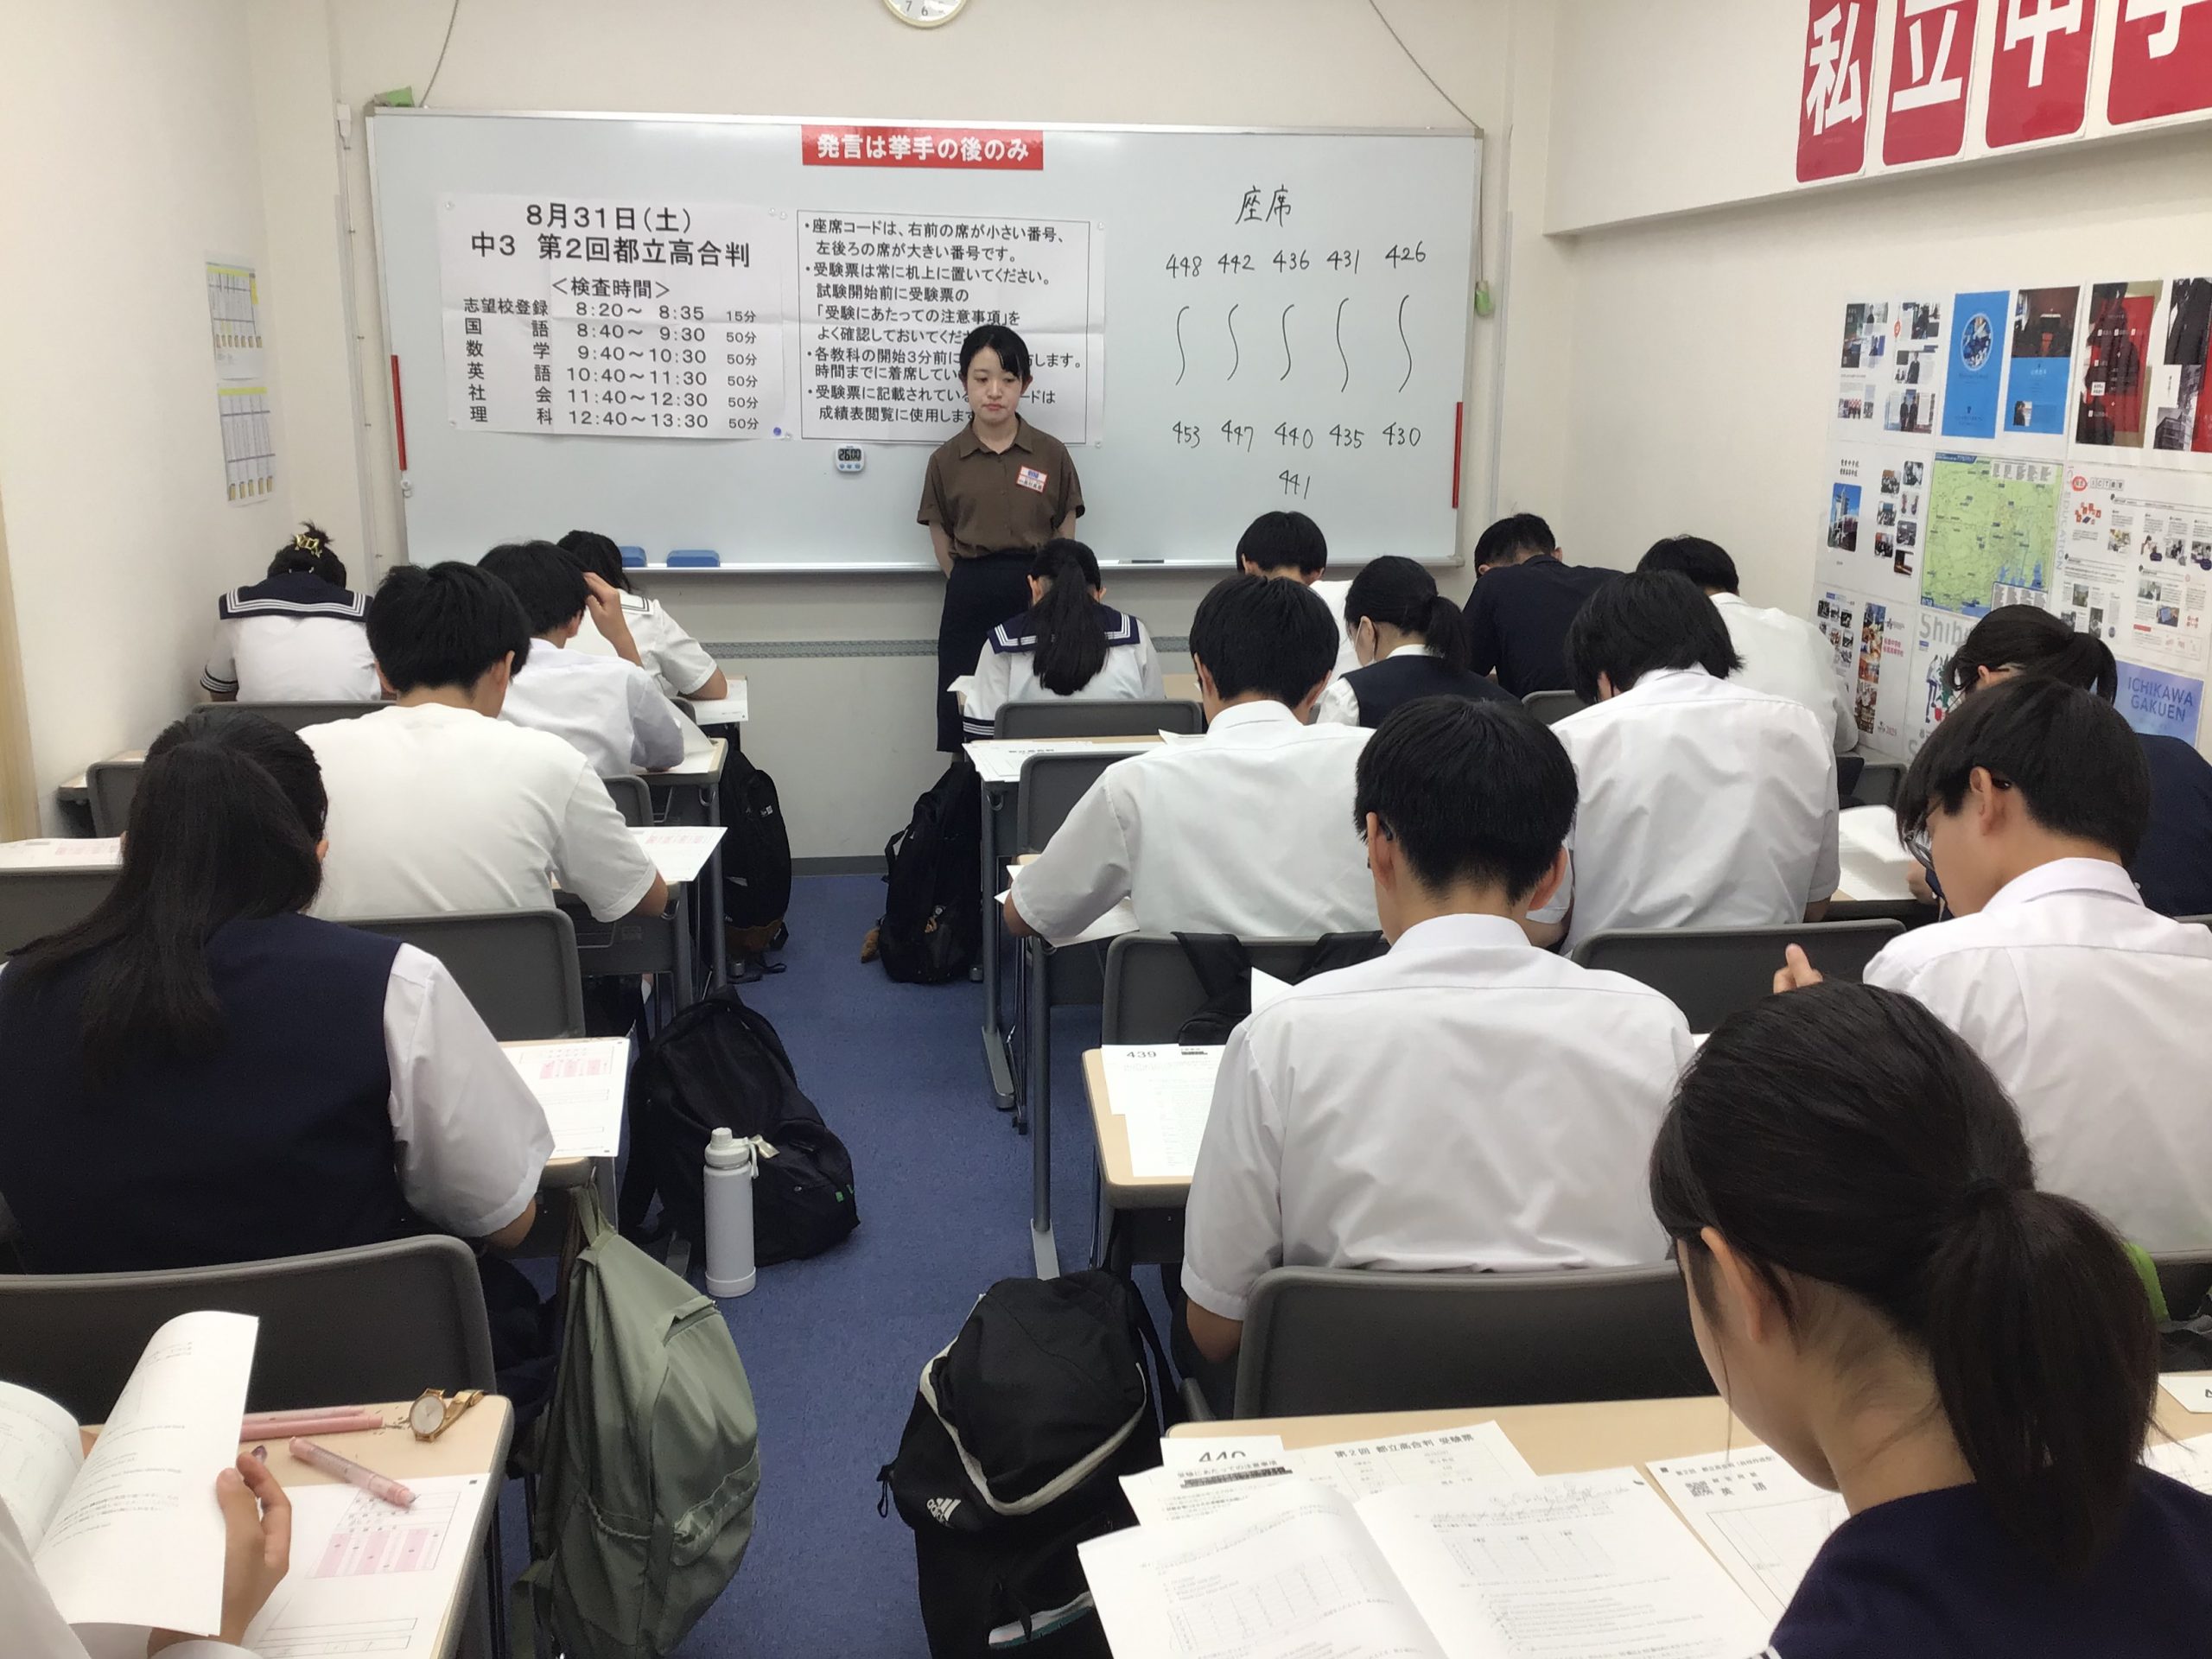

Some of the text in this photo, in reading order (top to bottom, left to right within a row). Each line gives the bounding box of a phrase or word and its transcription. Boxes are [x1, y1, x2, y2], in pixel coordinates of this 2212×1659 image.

[921, 6, 929, 16] 6
[817, 133, 1029, 162] 発言は挙手の後のみ
[526, 202, 692, 232] 8月31日（土）
[1235, 184, 1292, 227] 座席
[471, 231, 750, 268] 中3 第2回都立高合判
[817, 240, 1015, 263] 左後ろの席が大きい番号です。
[1166, 240, 1427, 278] 448 442 436 431 426
[817, 283, 969, 303] 試験開始前に受験票の
[463, 298, 549, 317] 志望校登録
[726, 310, 757, 323] 15分
[817, 303, 1020, 327] 「受験にあたっての注意事項」を
[726, 331, 758, 345] 50分
[727, 353, 758, 366] 50分
[728, 374, 759, 388] 50分
[728, 396, 760, 410] 50分
[728, 417, 760, 430] 50分
[1172, 419, 1421, 453] 453 447 440 435 430
[1279, 470, 1311, 499] 441
[2127, 677, 2194, 707] ICHIKAWA
[2130, 695, 2186, 722] GAKUEN
